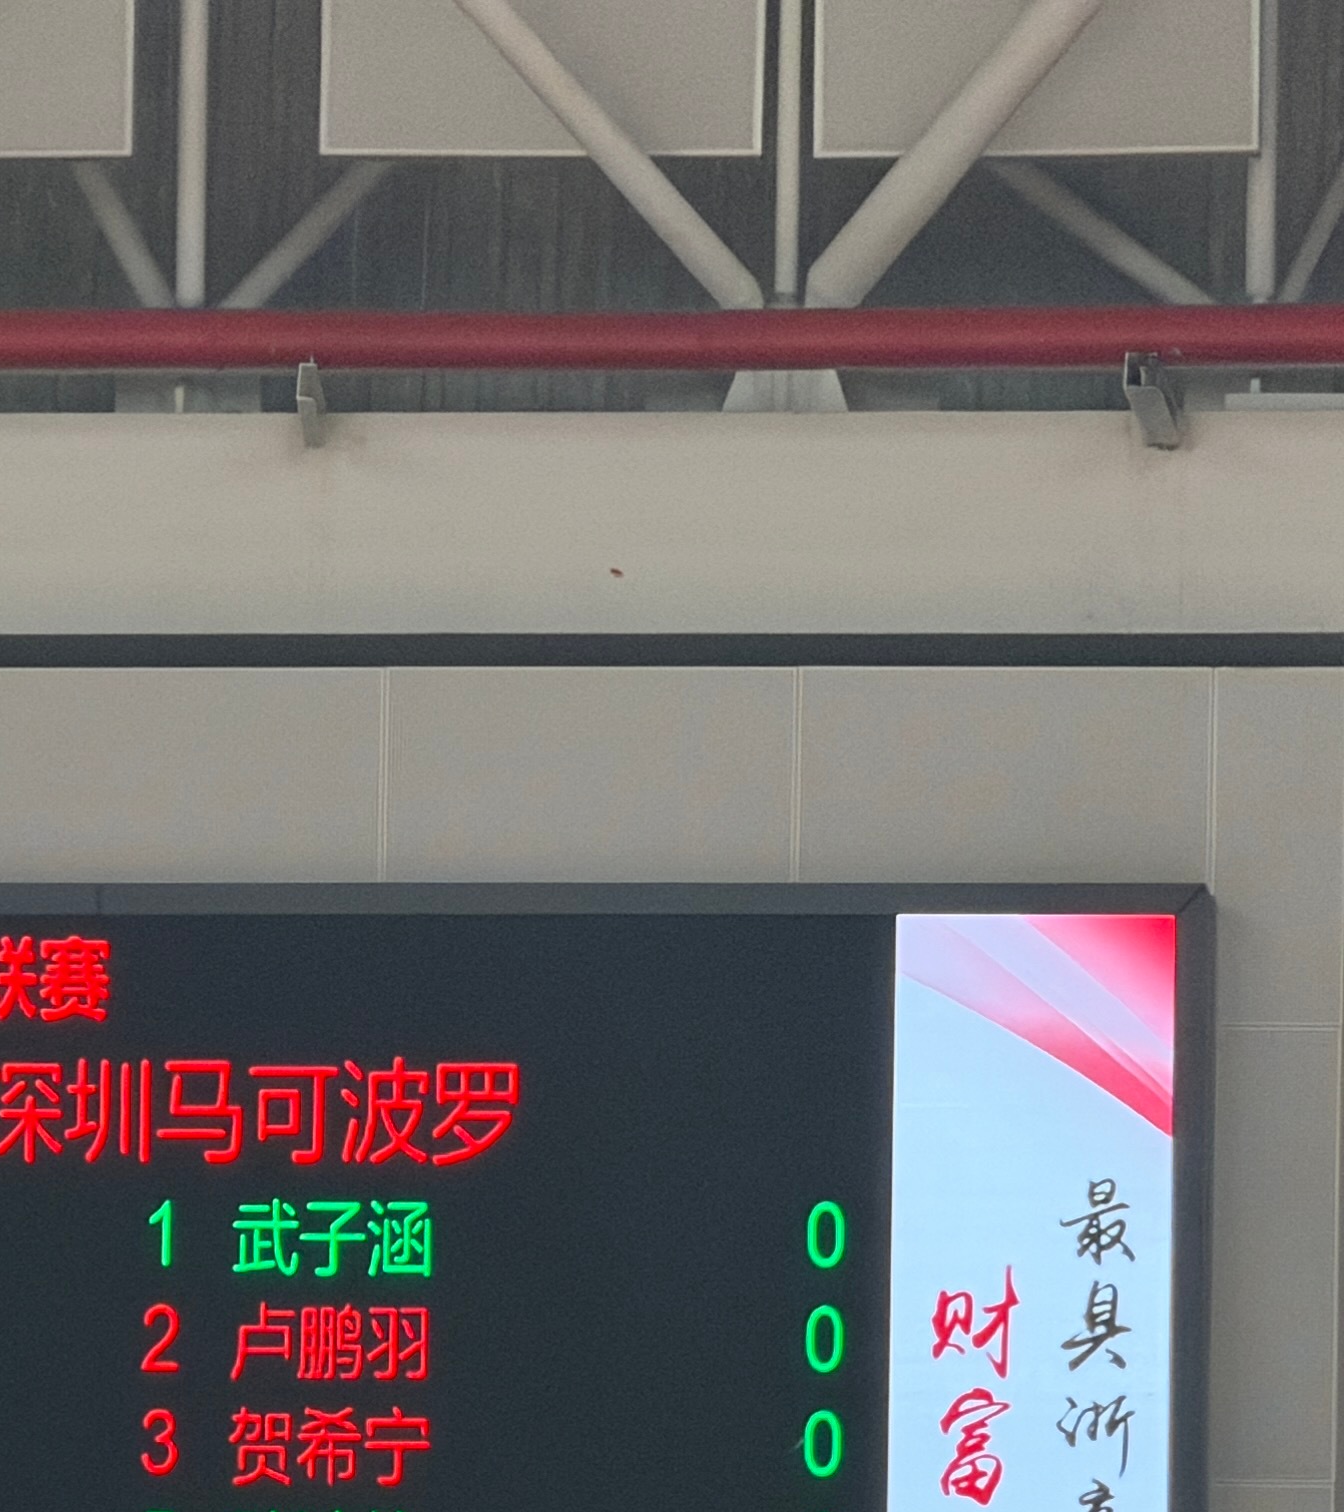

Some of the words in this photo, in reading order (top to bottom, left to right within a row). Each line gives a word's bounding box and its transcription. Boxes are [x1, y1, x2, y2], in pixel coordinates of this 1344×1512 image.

[149, 1200, 171, 1266] 1
[232, 1198, 431, 1277] 武子涵
[807, 1201, 845, 1268] 0
[141, 1303, 180, 1373] 2
[230, 1302, 429, 1381] 卢鹏羽
[806, 1305, 844, 1373] 0
[141, 1409, 178, 1475] 3
[229, 1406, 431, 1487] 贺希宁
[802, 1410, 842, 1477] 0
